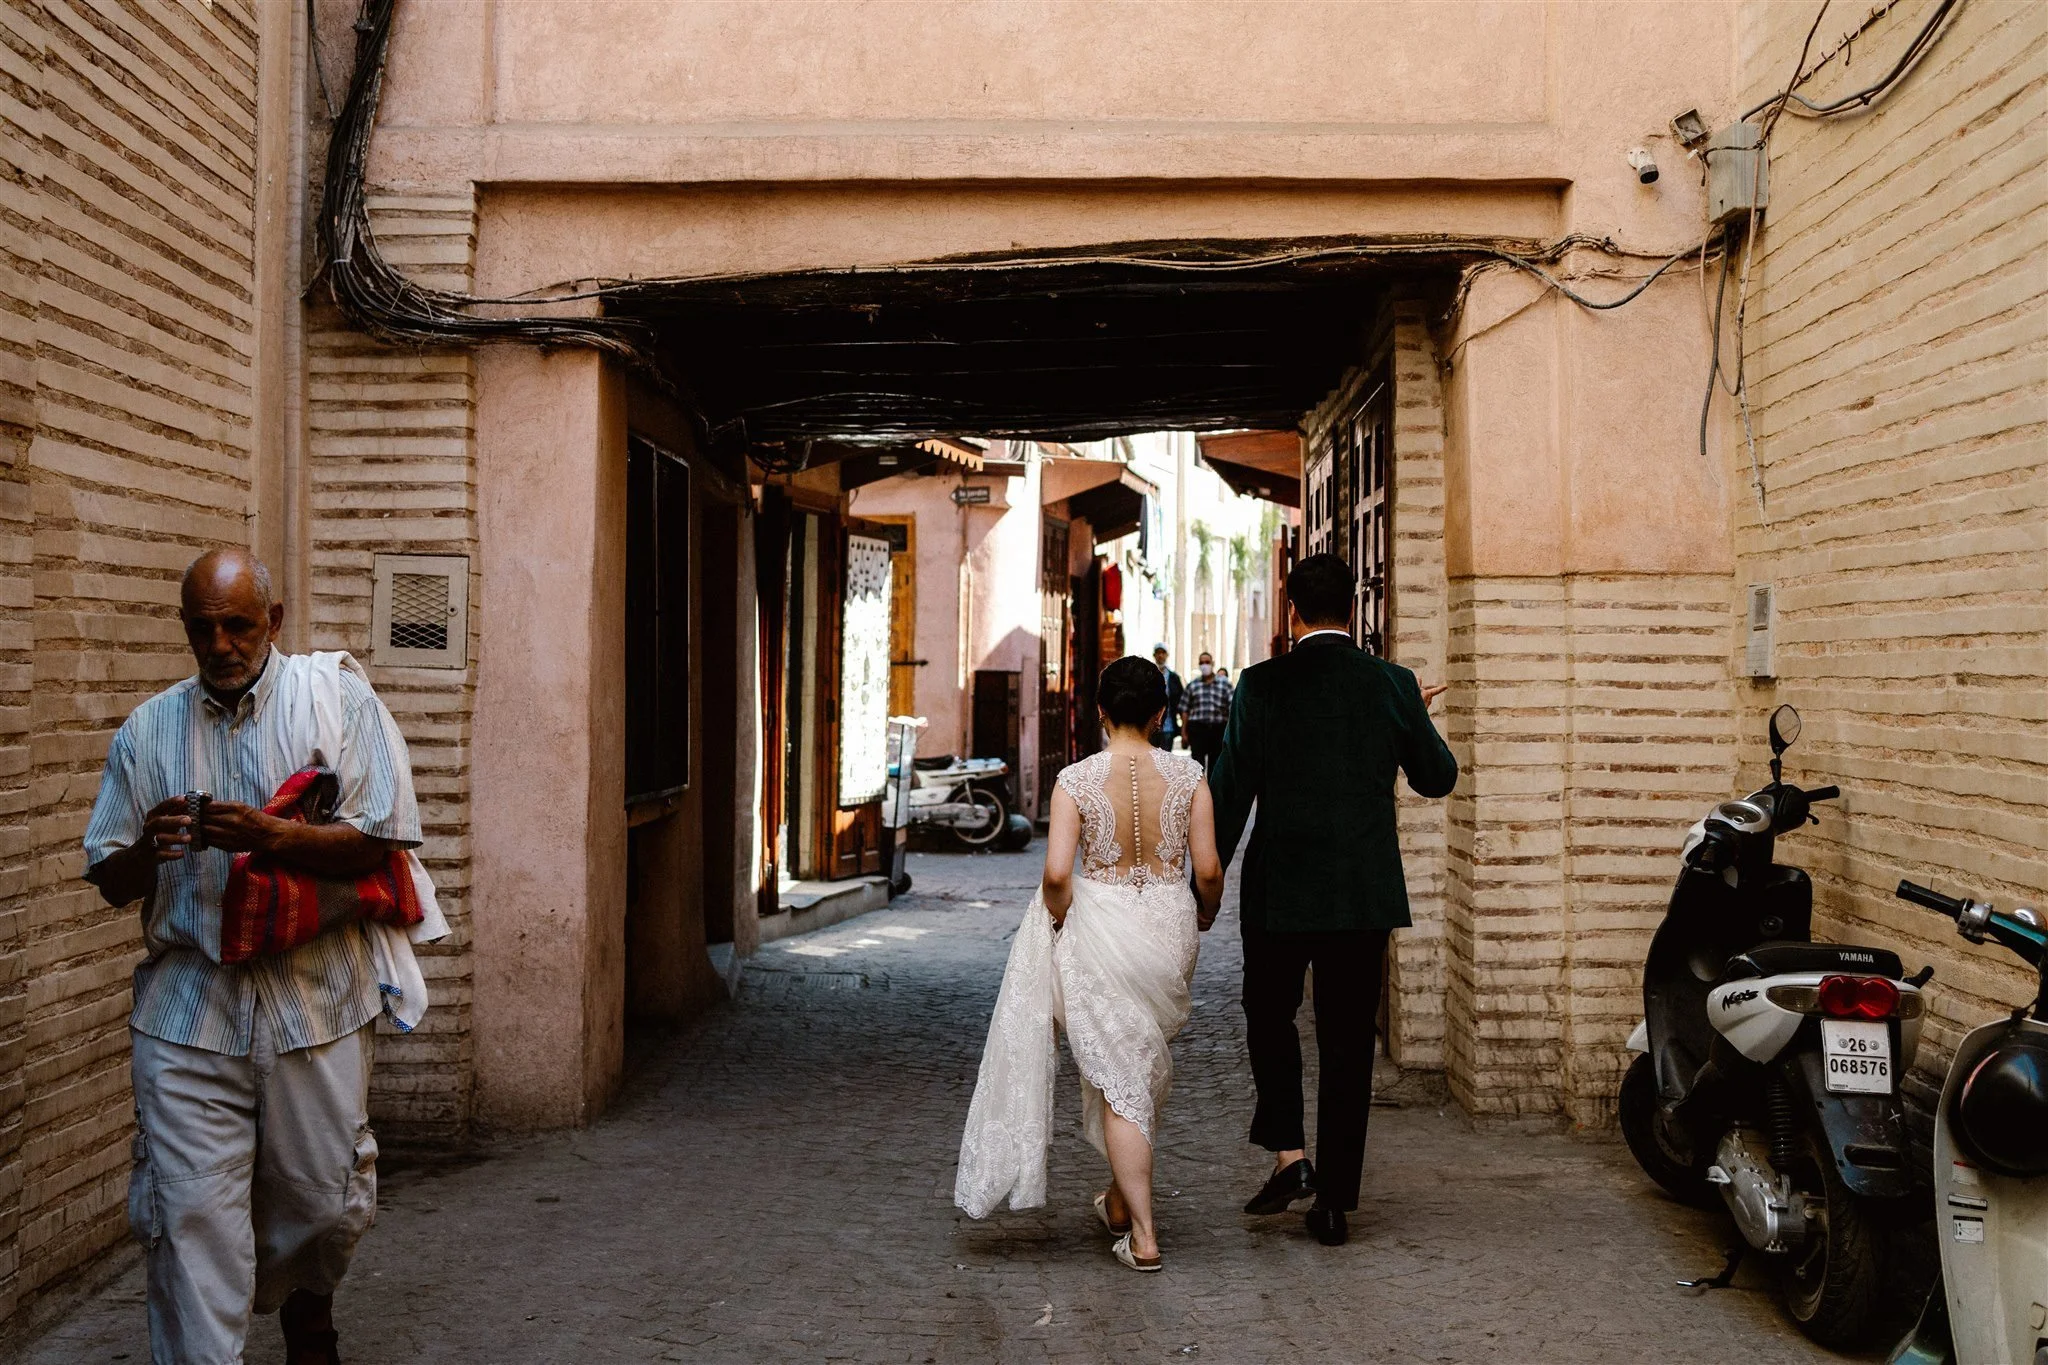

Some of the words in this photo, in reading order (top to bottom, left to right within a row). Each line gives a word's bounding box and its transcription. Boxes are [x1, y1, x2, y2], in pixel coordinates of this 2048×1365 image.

[1839, 952, 1874, 964] YAMAHA
[1848, 1037, 1867, 1052] 26
[1830, 1058, 1888, 1076] 068576
